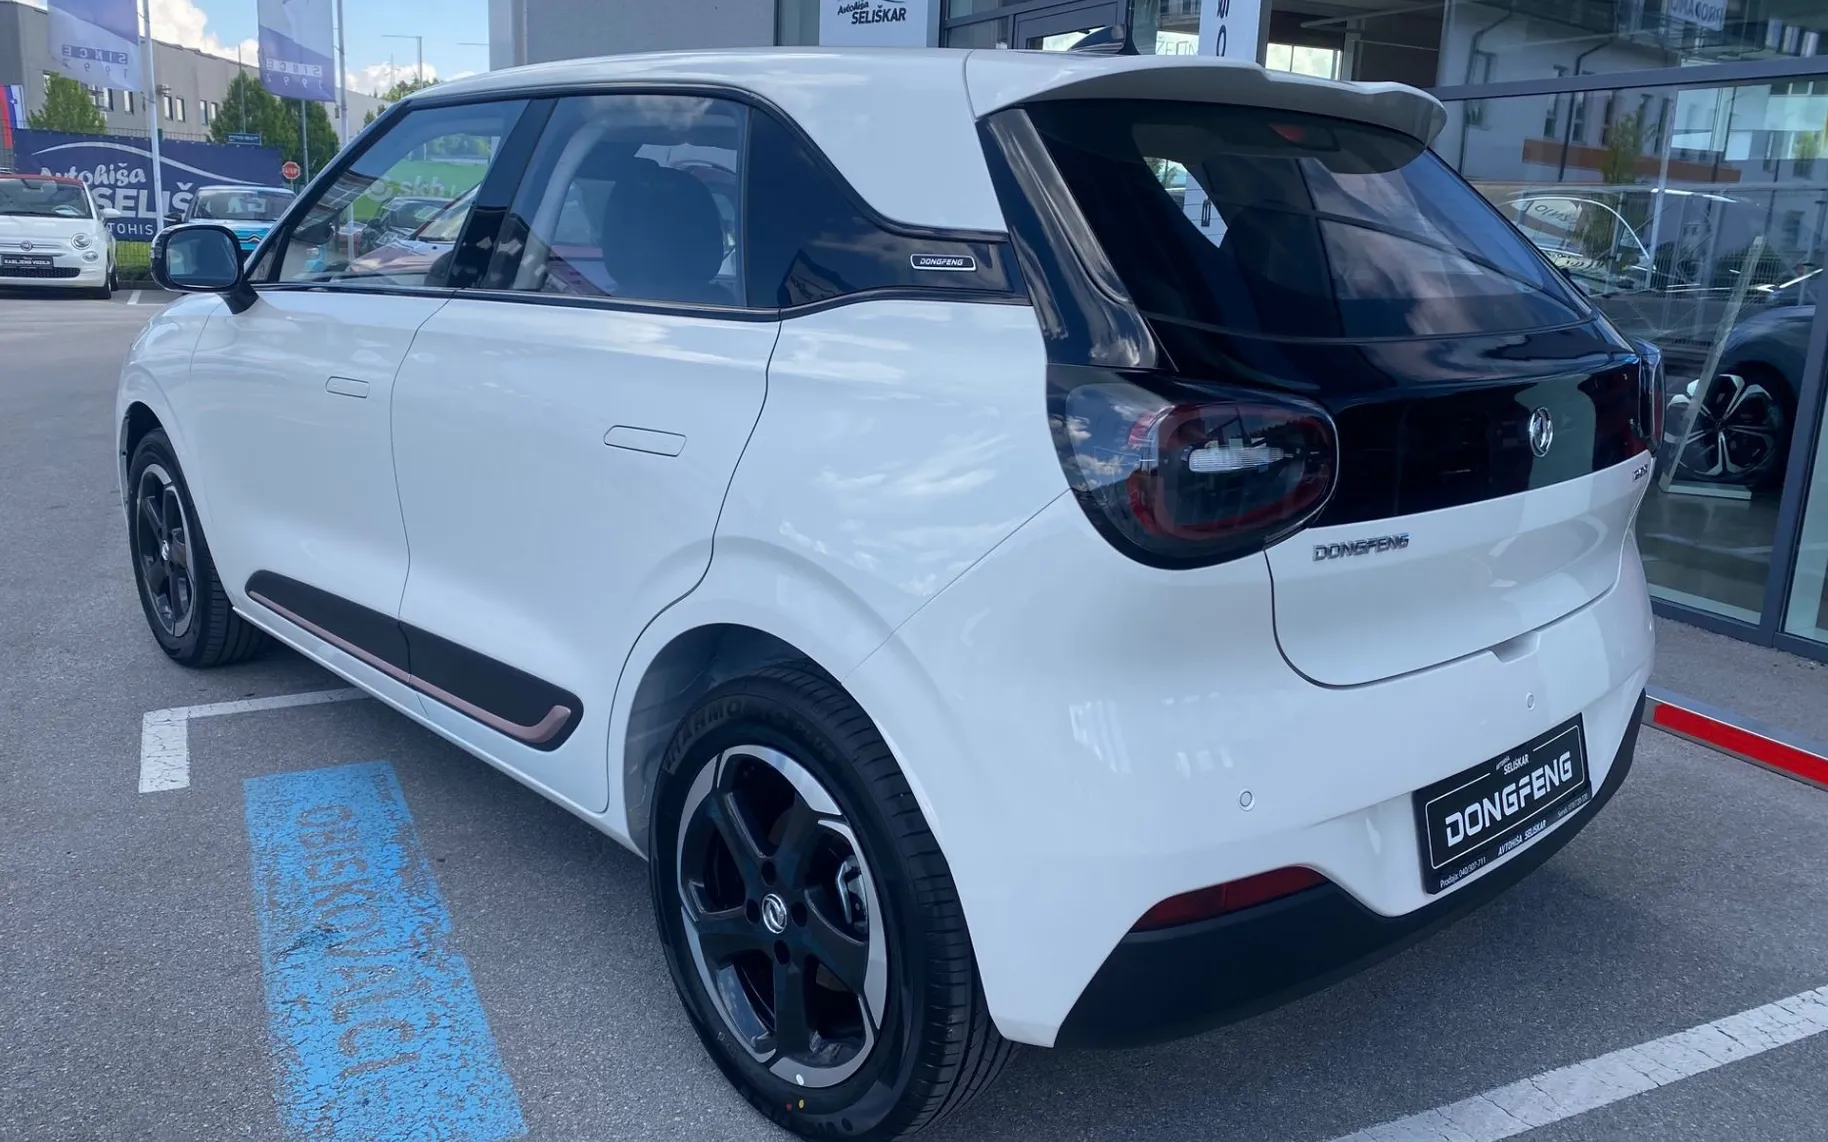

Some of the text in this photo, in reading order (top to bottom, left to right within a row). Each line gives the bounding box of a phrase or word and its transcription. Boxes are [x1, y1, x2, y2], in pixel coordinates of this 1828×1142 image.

[851, 4, 907, 25] SELIŠKAR
[920, 258, 964, 266] DONGFENG
[1313, 532, 1410, 561] DONGFENG
[1445, 751, 1572, 847] DONGFENG
